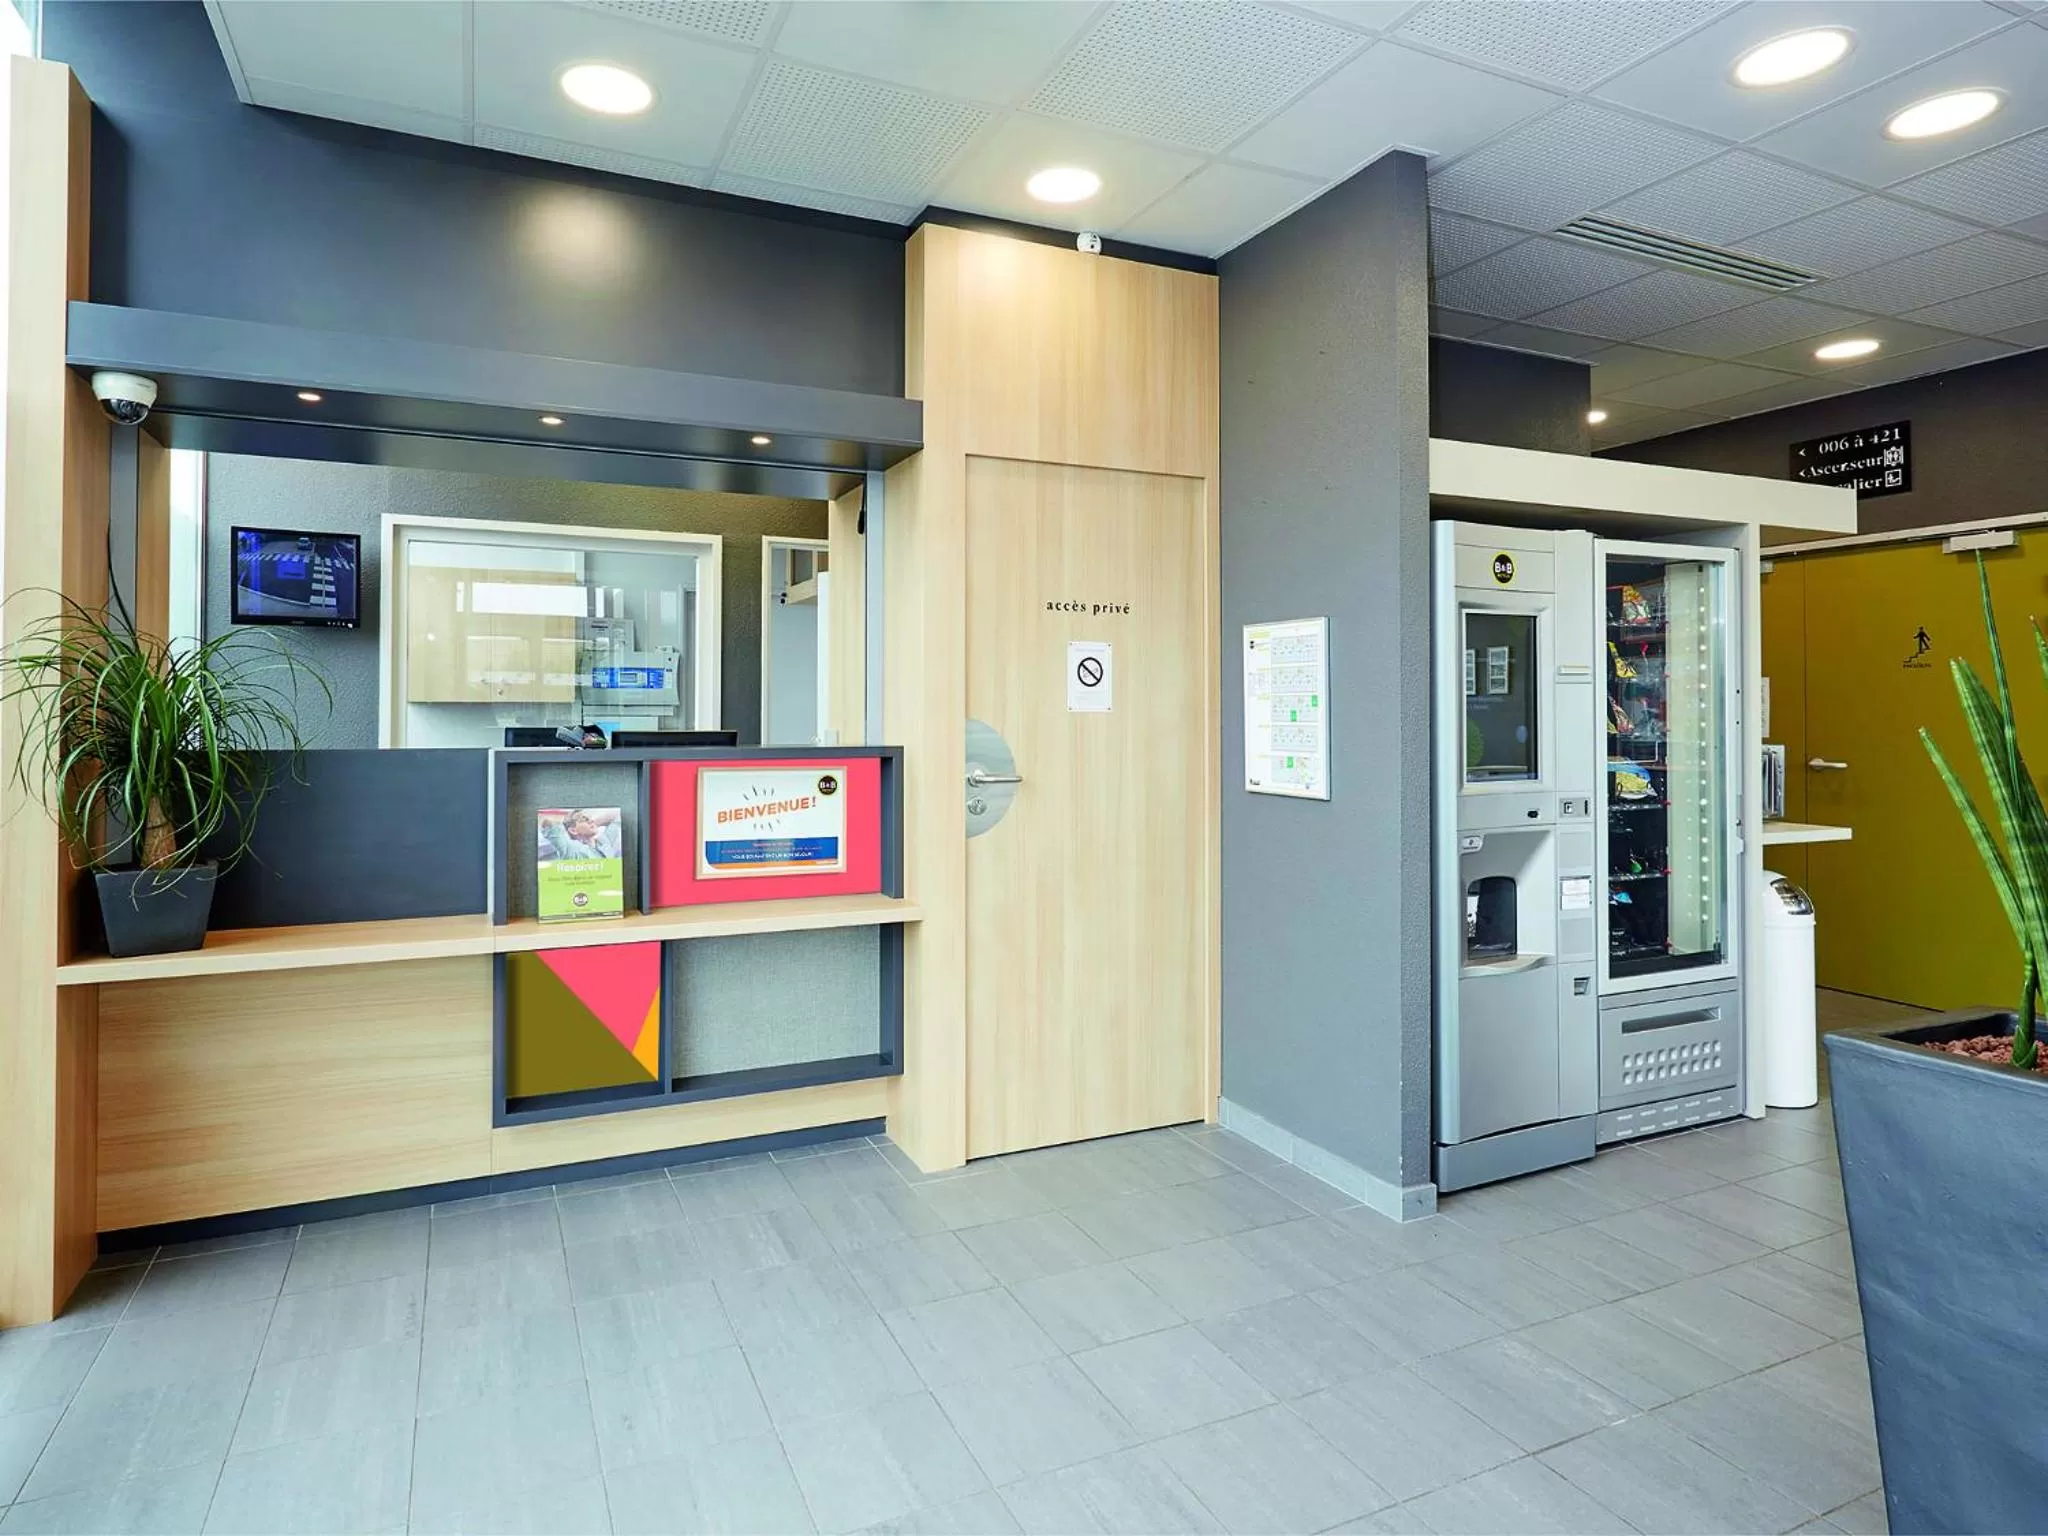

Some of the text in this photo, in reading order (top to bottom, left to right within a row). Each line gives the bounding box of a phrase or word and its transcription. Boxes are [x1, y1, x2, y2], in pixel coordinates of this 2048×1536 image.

[1819, 427, 1901, 455] 006 à 421
[1046, 600, 1131, 616] accès privé
